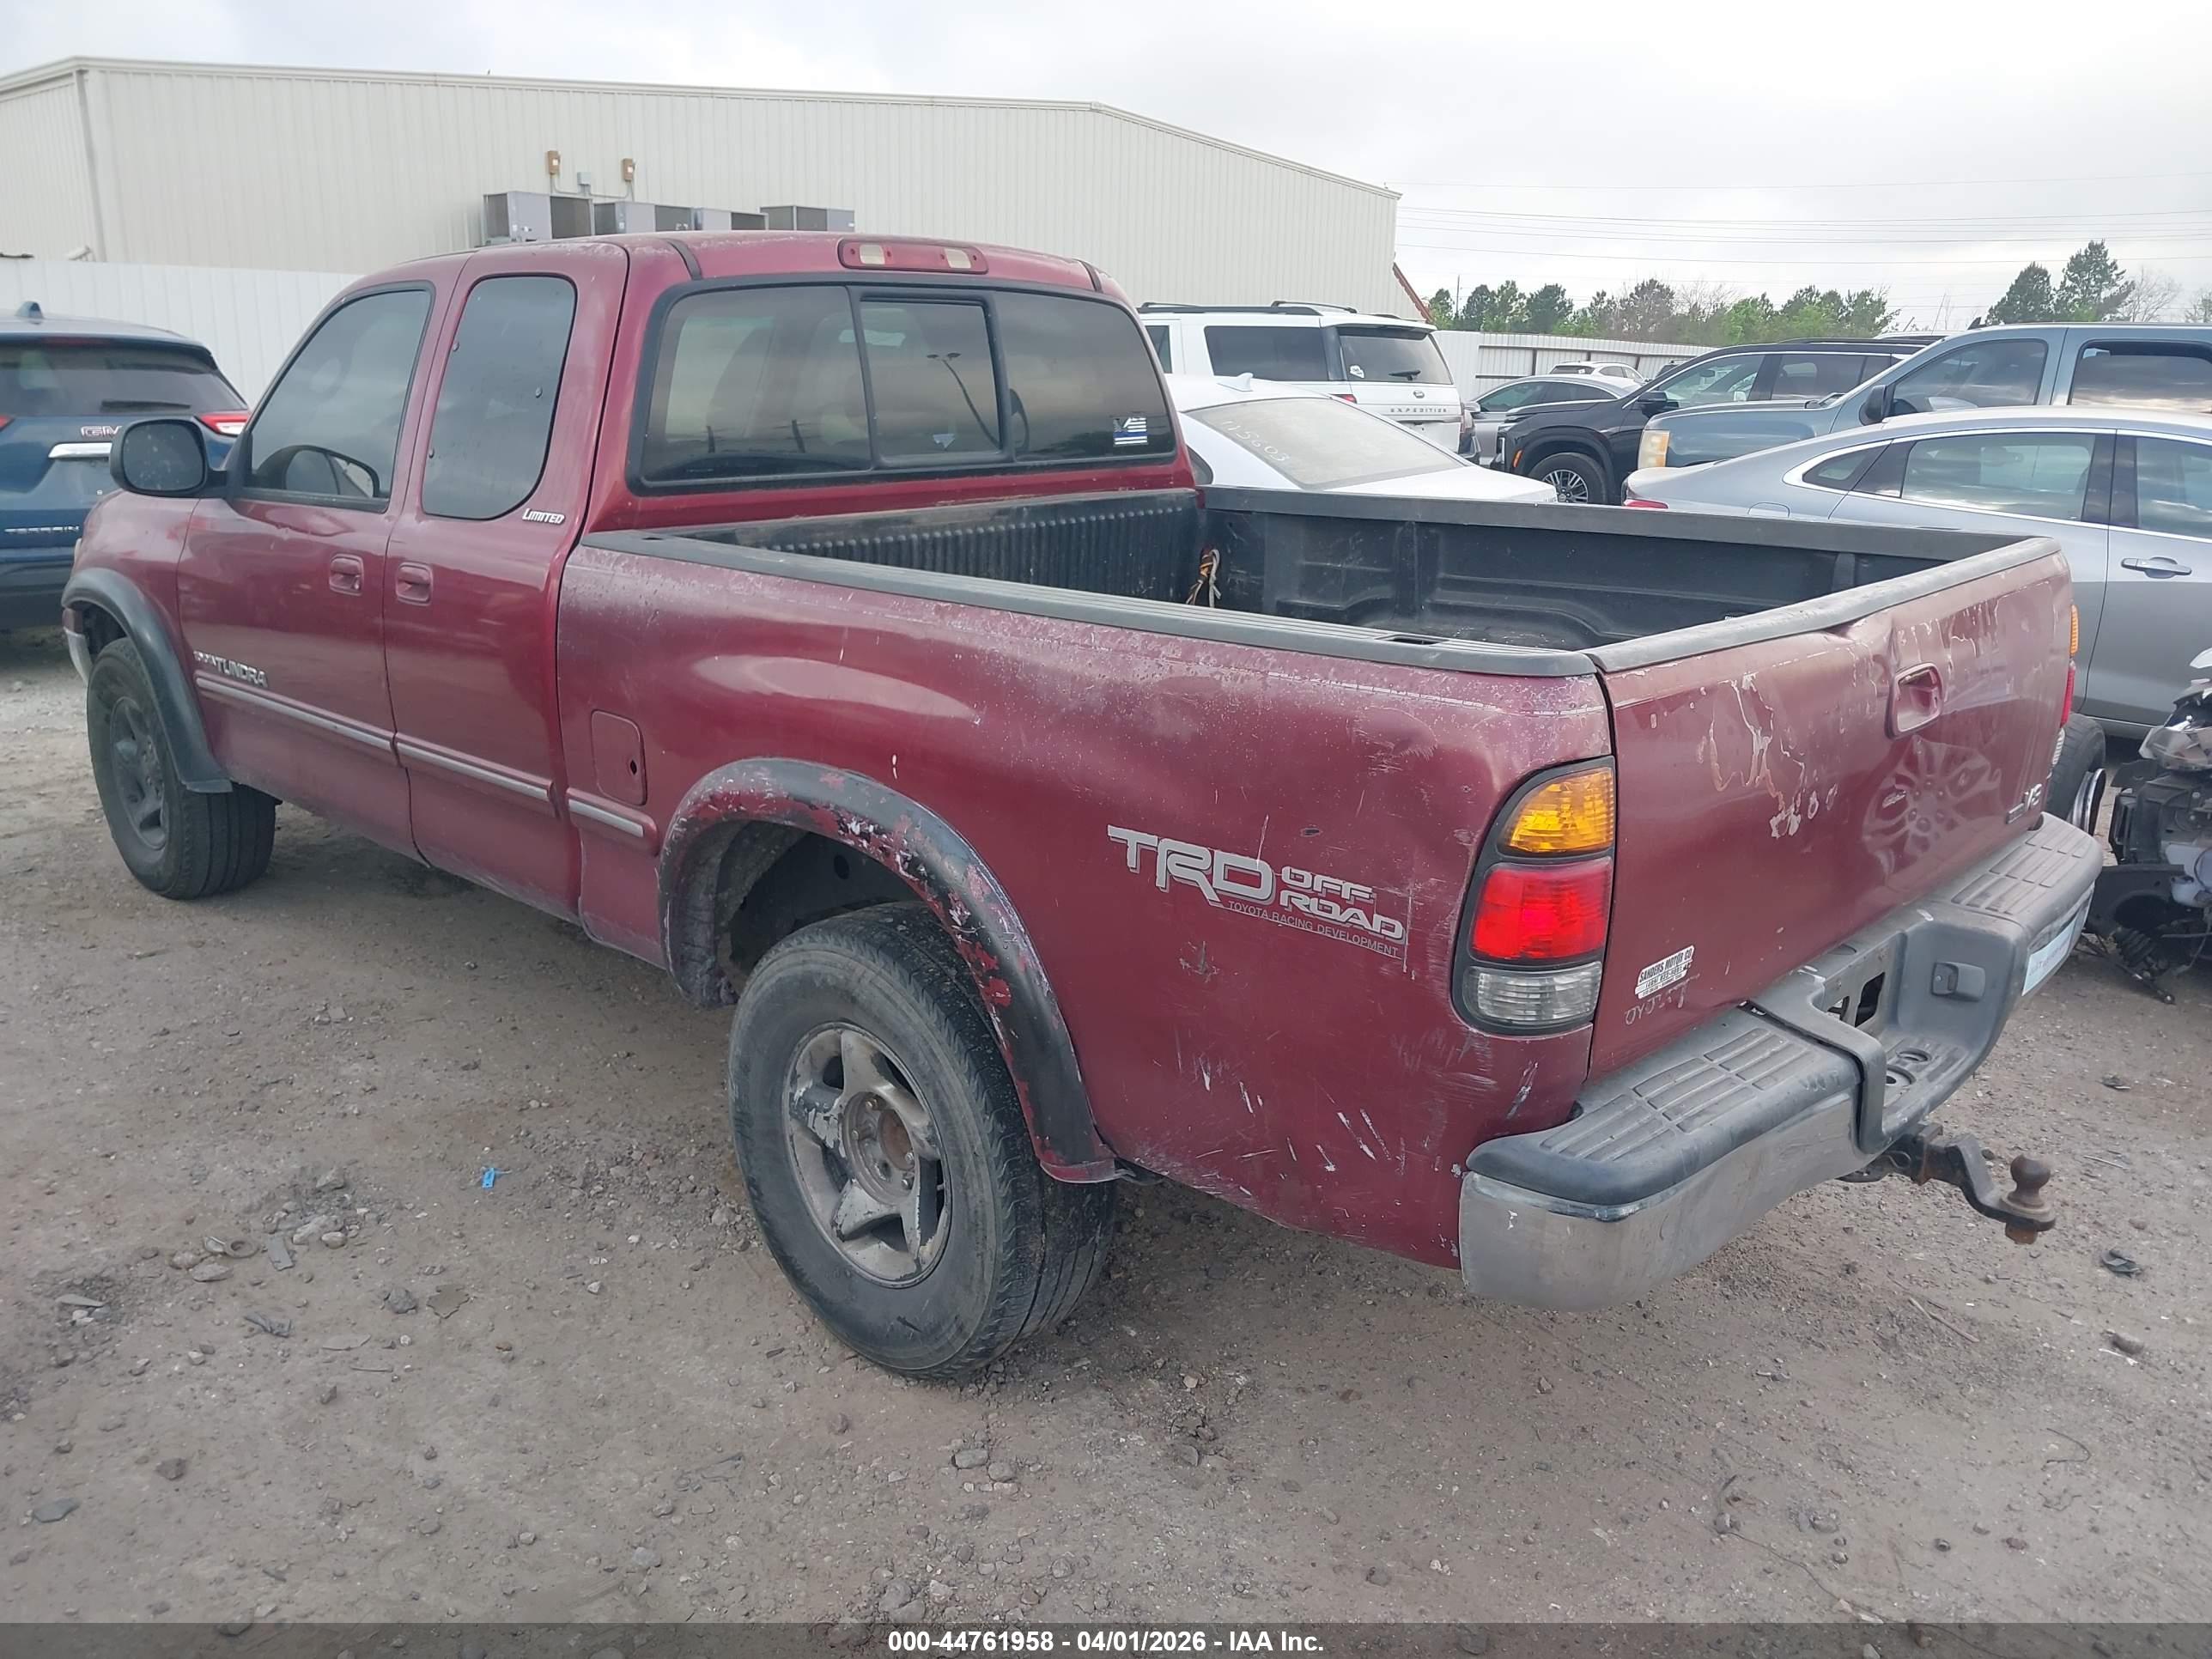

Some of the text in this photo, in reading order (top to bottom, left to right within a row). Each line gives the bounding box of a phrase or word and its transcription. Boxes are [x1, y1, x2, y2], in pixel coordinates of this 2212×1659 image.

[81, 425, 123, 437] GM
[215, 656, 268, 688] TUNDRA
[1107, 824, 1276, 908] TRD
[1281, 866, 1376, 904] OFF
[1228, 901, 1400, 957] TOYOTA RACING DEVELOPMENT
[1279, 890, 1407, 945] ROAD
[1638, 962, 1664, 983] SANDERS
[1664, 951, 1684, 970] MOTOR
